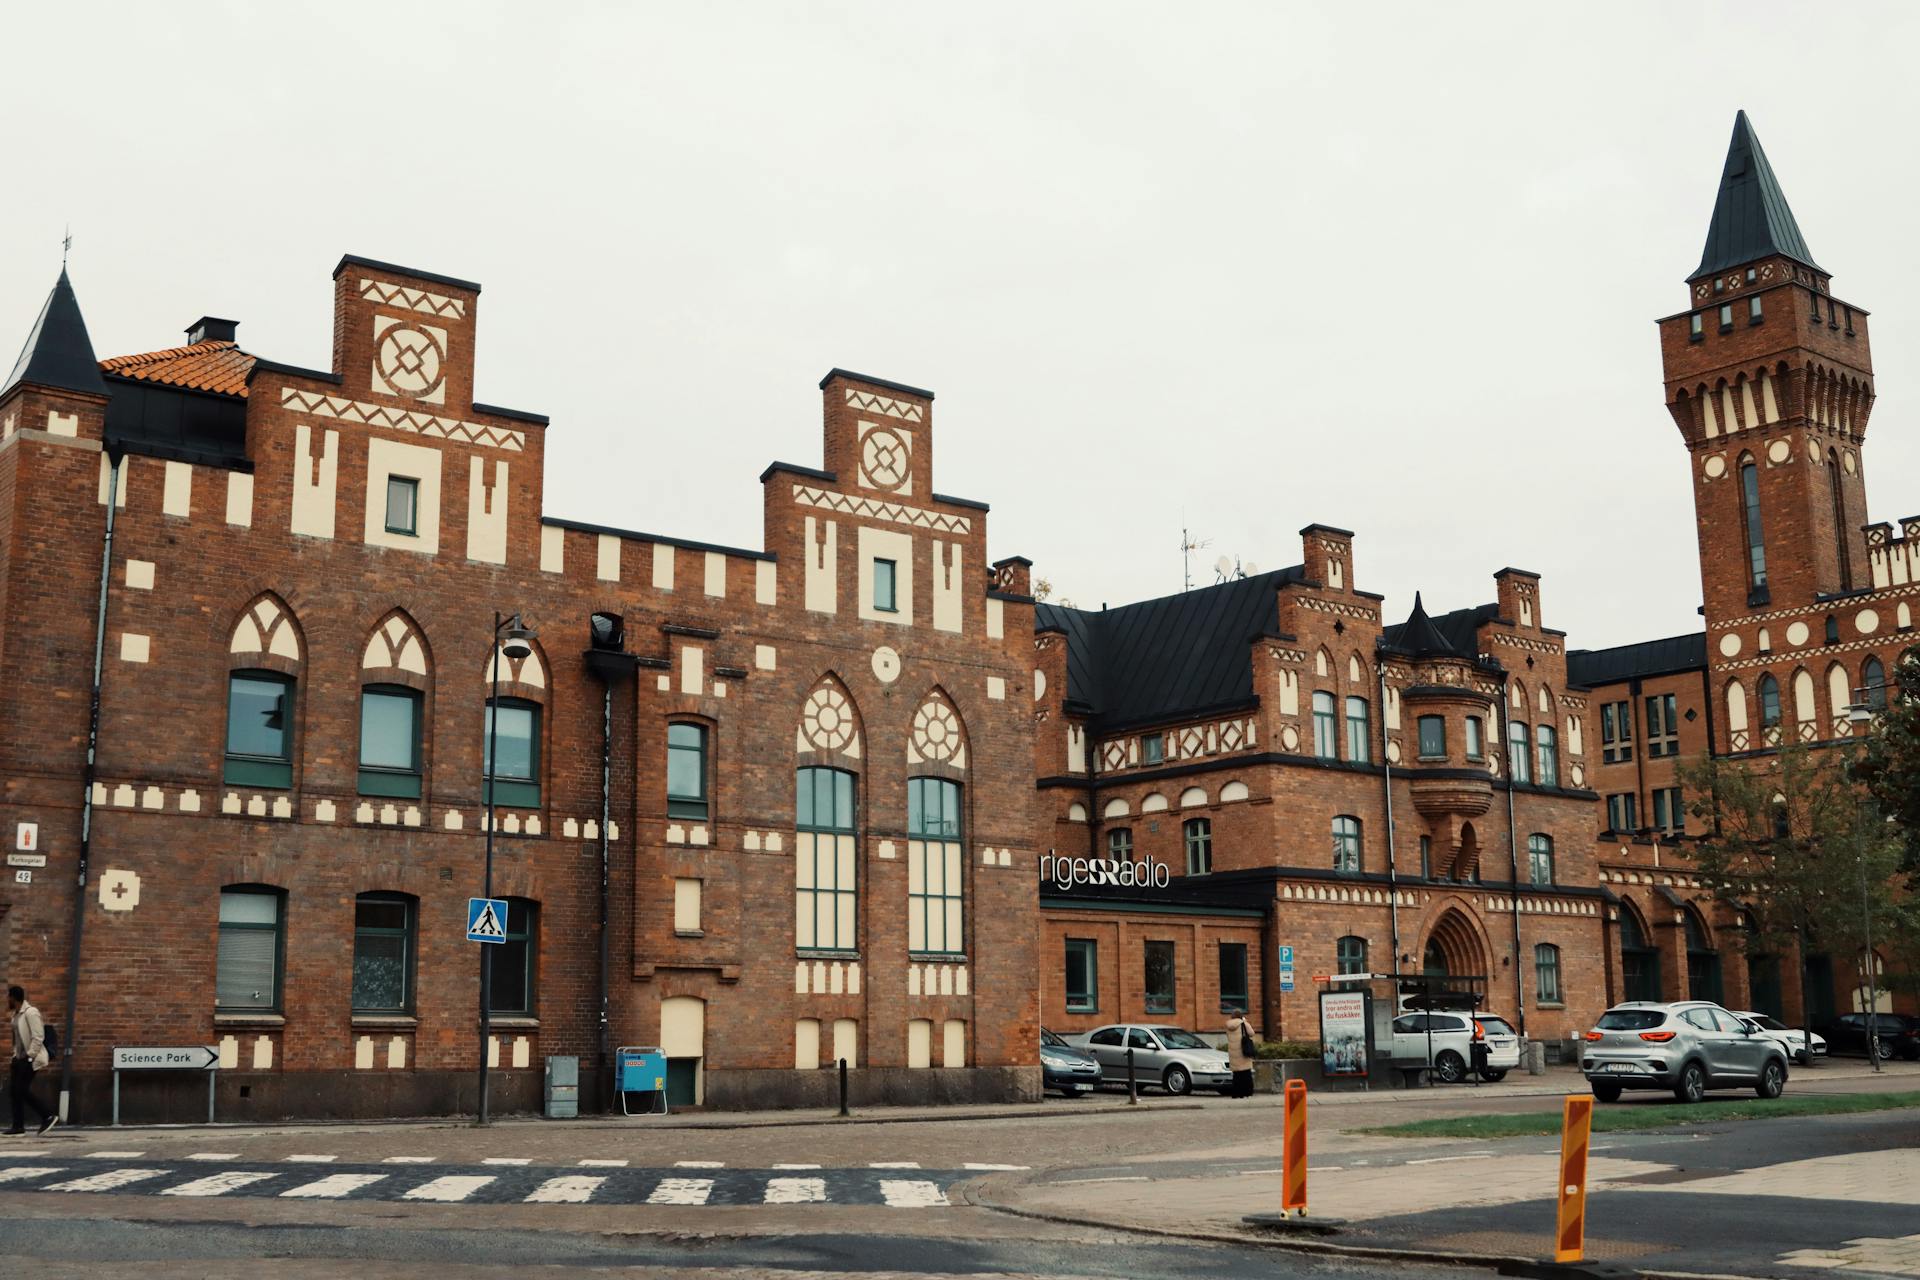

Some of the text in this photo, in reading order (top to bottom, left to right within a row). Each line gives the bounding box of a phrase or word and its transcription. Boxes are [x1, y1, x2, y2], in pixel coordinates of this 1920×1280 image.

[18, 872, 29, 882] 42
[121, 1053, 191, 1063] Science Park
